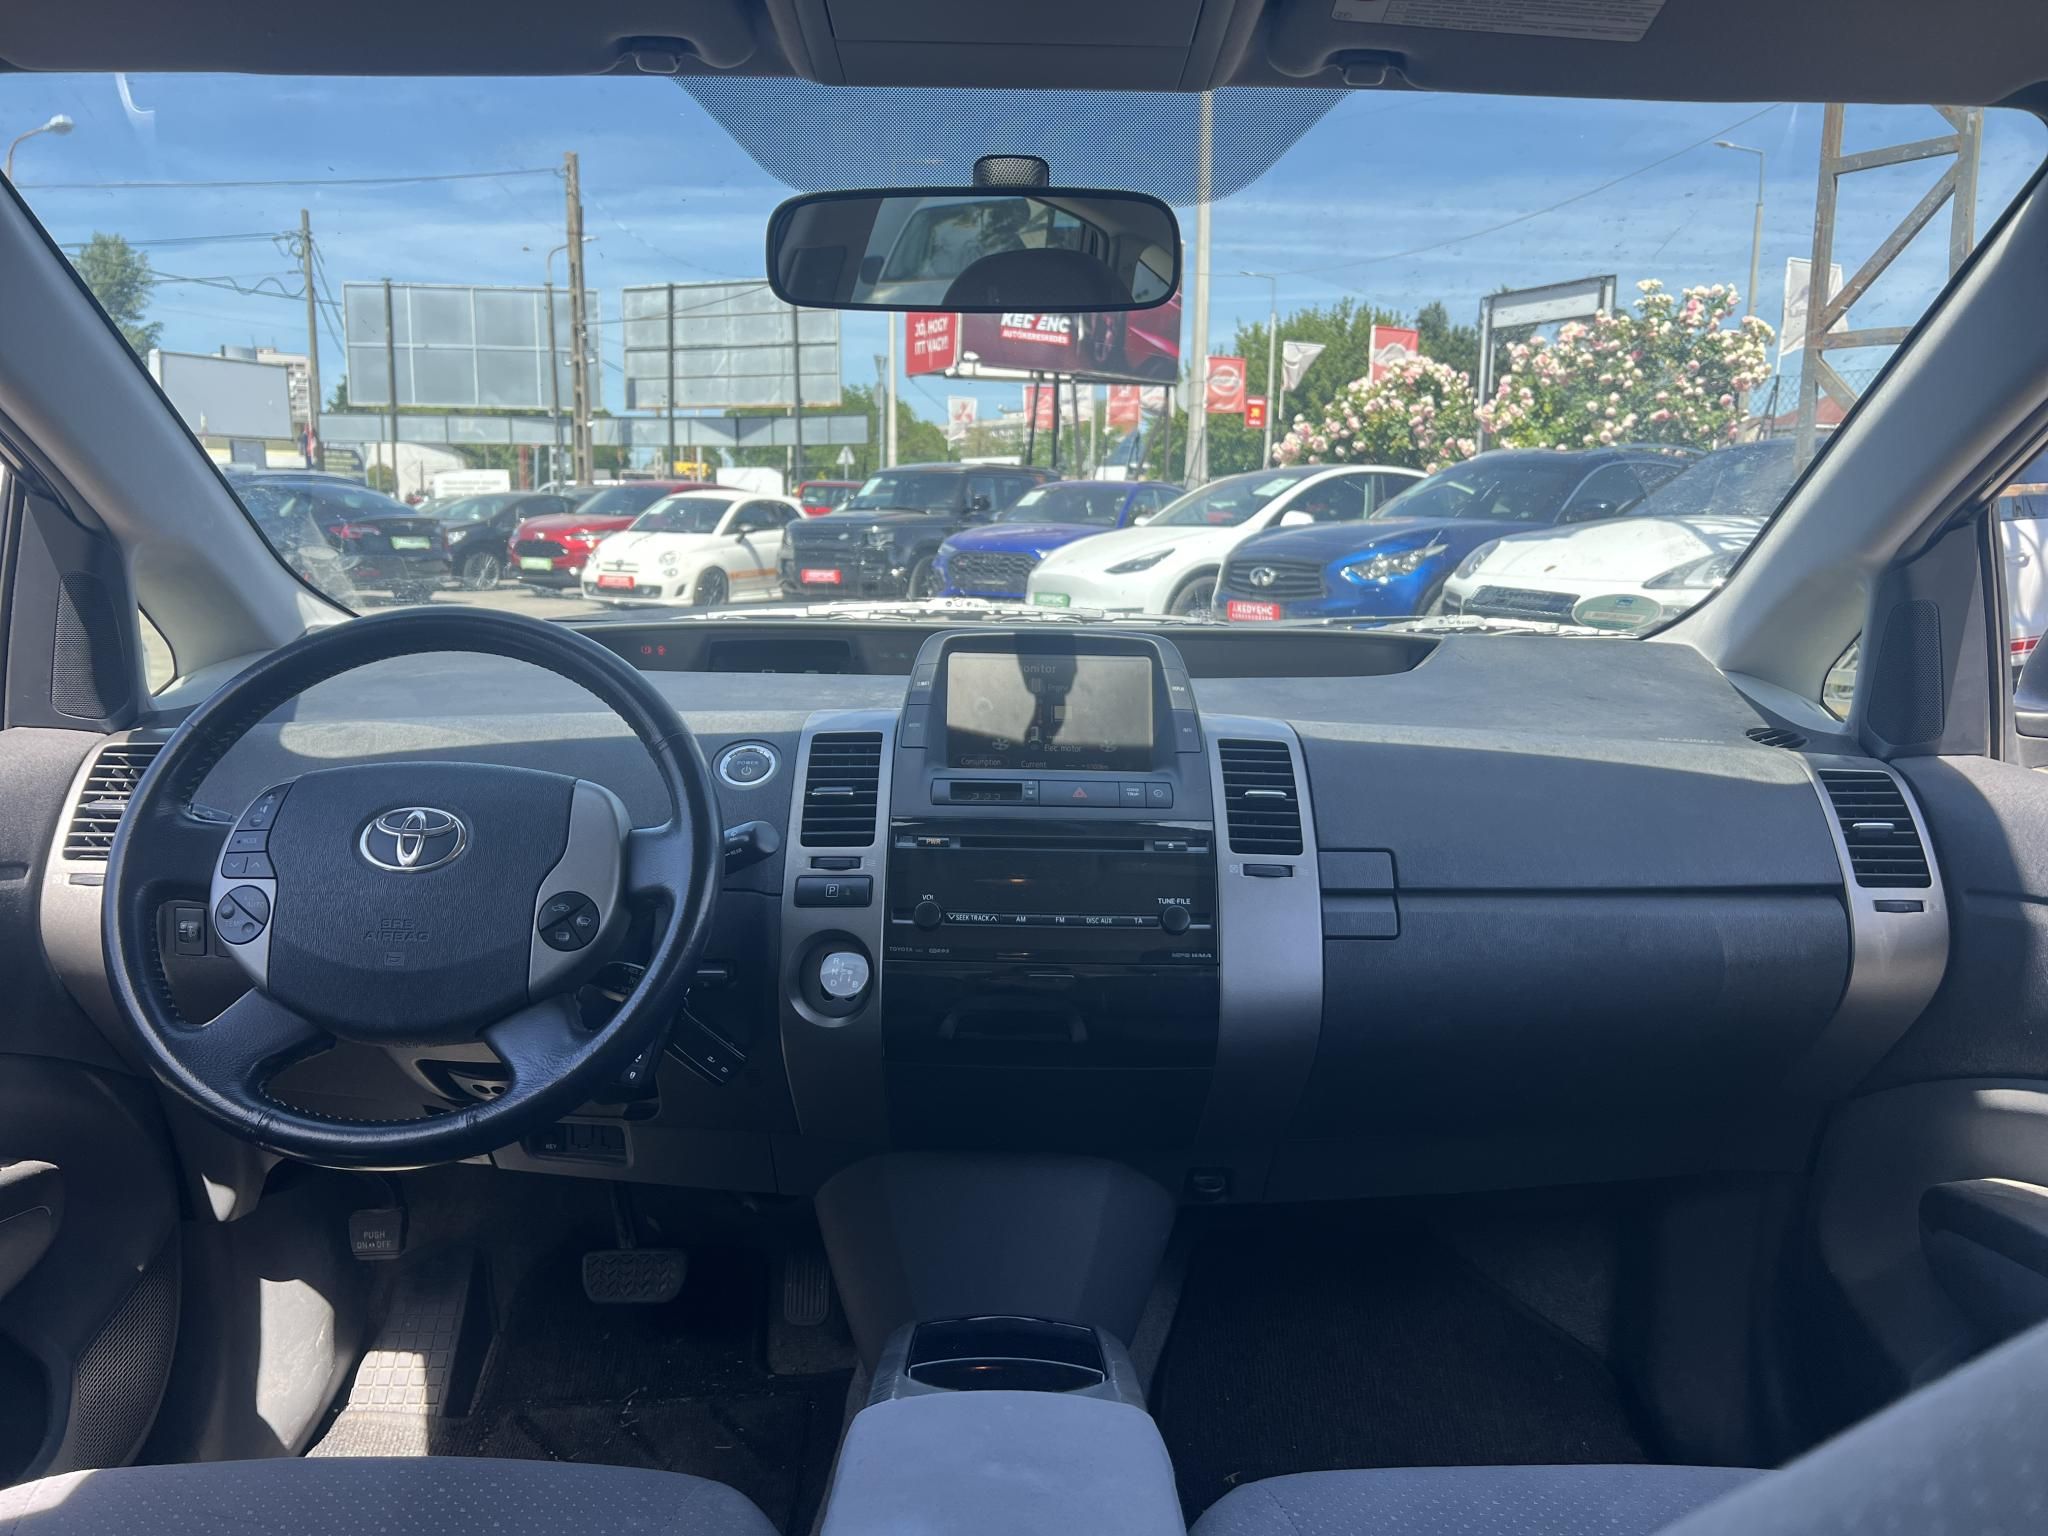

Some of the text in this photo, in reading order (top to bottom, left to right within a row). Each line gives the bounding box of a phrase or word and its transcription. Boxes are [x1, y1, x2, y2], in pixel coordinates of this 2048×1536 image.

[928, 317, 948, 334] HOGY
[914, 340, 926, 355] ITT
[1022, 663, 1056, 674] onitor
[1060, 744, 1081, 753] motor
[960, 757, 1001, 768] Consumption
[1021, 760, 1047, 769] Current
[1158, 897, 1175, 905] TUNE
[362, 931, 430, 942] AIRBAG
[363, 1231, 385, 1240] PUSH
[356, 1240, 392, 1249] ON OFF
